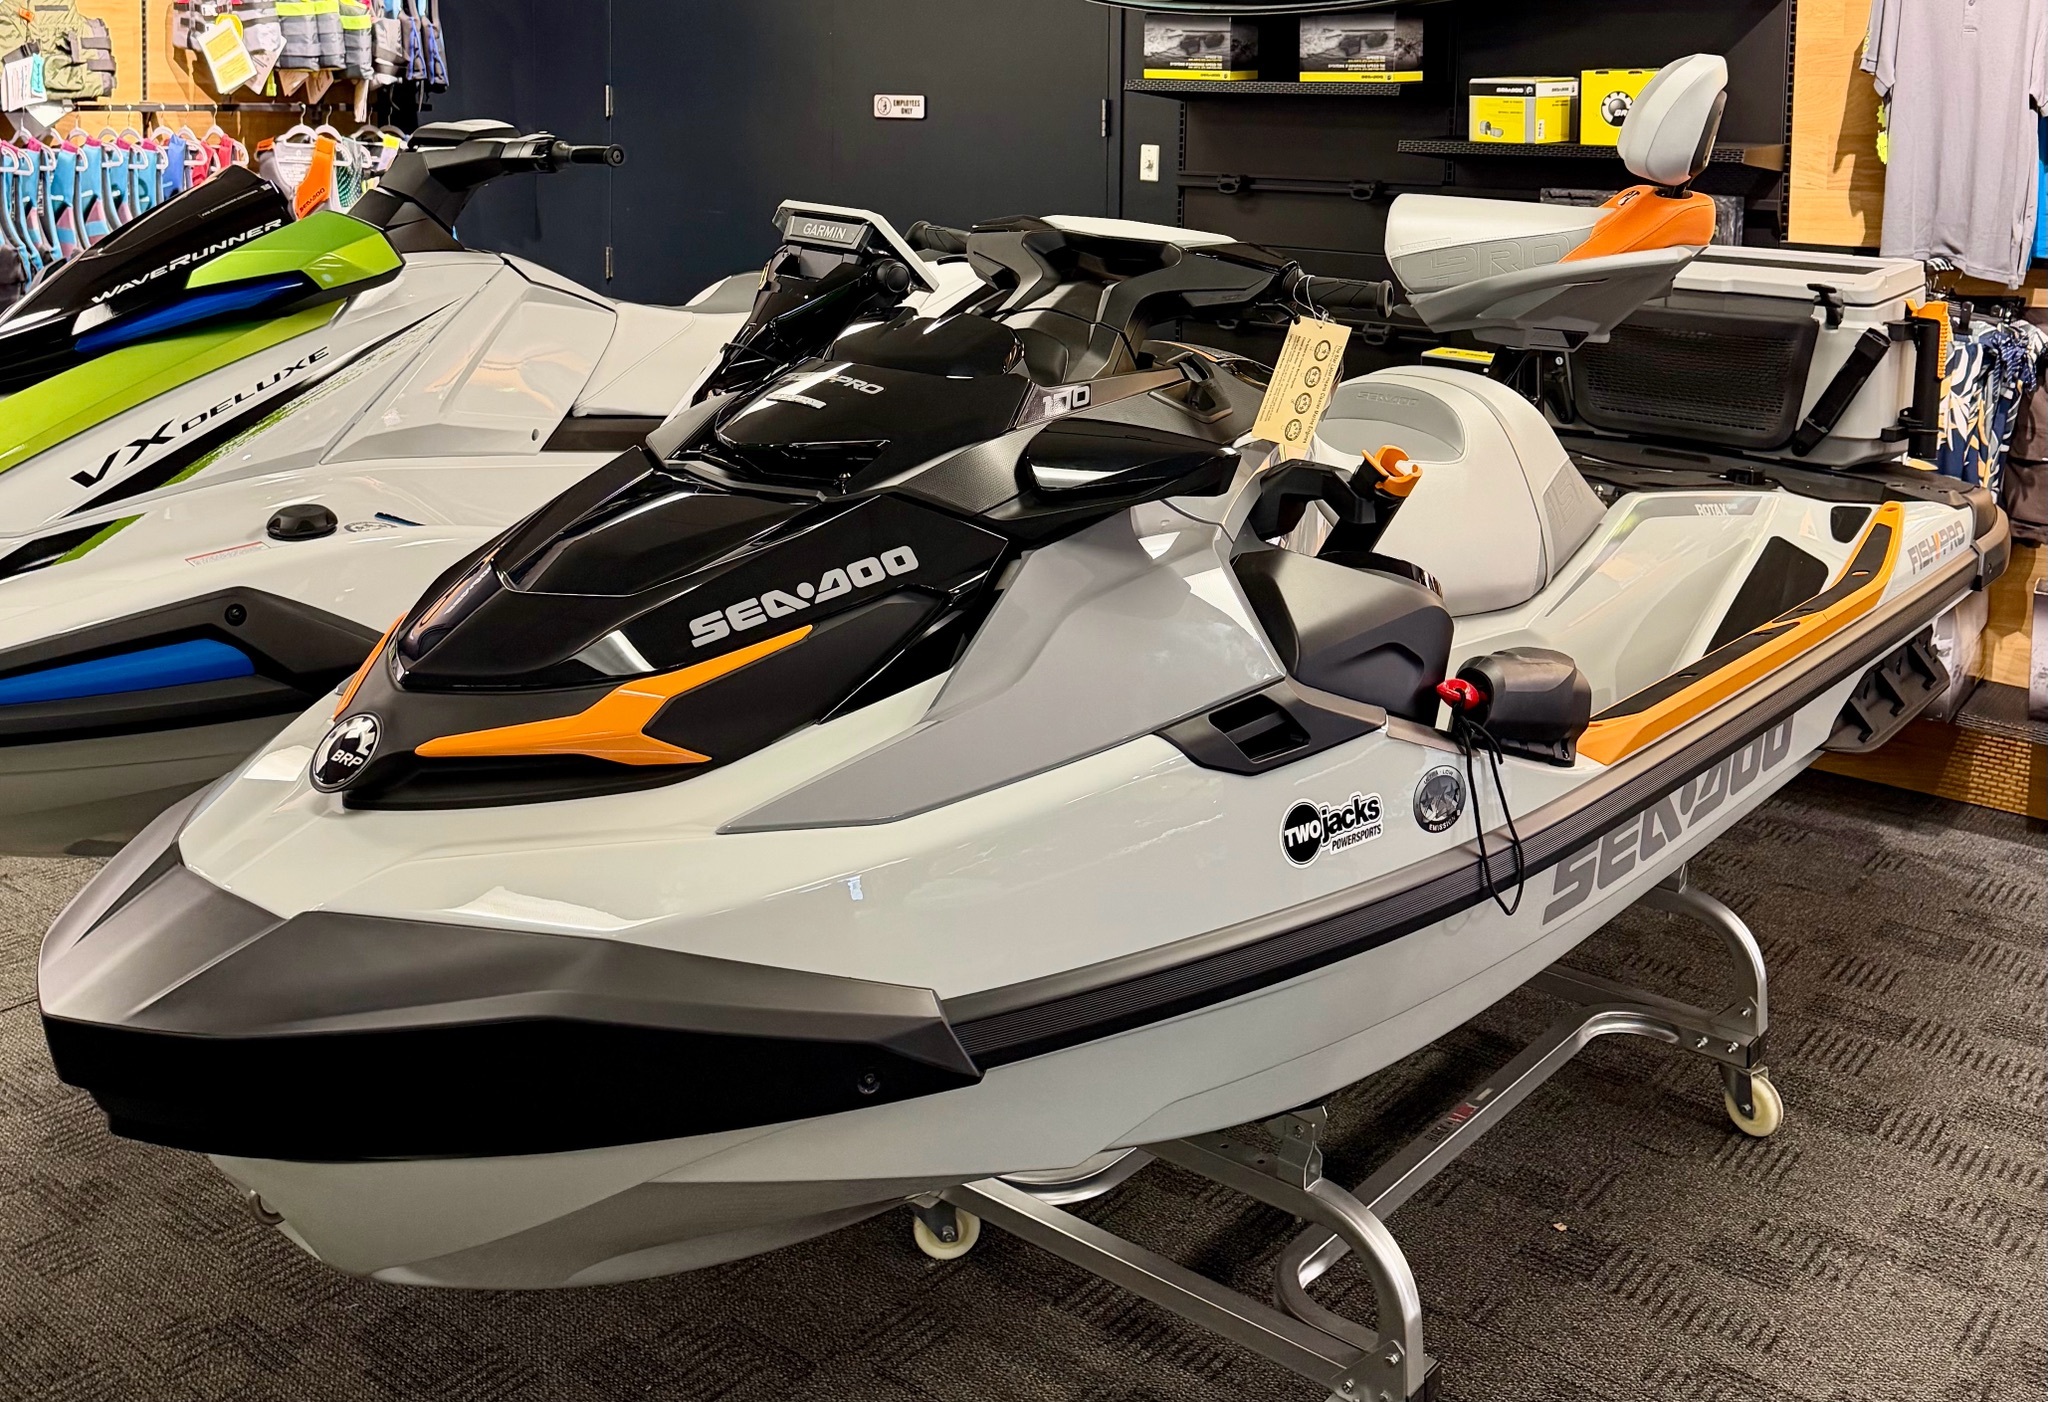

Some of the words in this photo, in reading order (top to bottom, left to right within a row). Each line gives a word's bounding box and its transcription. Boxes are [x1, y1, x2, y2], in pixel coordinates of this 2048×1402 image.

[1613, 108, 1629, 118] BR
[802, 222, 847, 240] GARMIN
[90, 218, 283, 304] WAVERUNNER
[1043, 385, 1091, 417] 170
[69, 418, 177, 488] VX
[181, 346, 330, 434] DELUXE
[1694, 503, 1730, 516] ROTAX
[330, 749, 364, 767] BRP
[1284, 819, 1321, 848] TWO
[1321, 798, 1380, 844] jacks
[1331, 823, 1382, 851] POWERSPORTS
